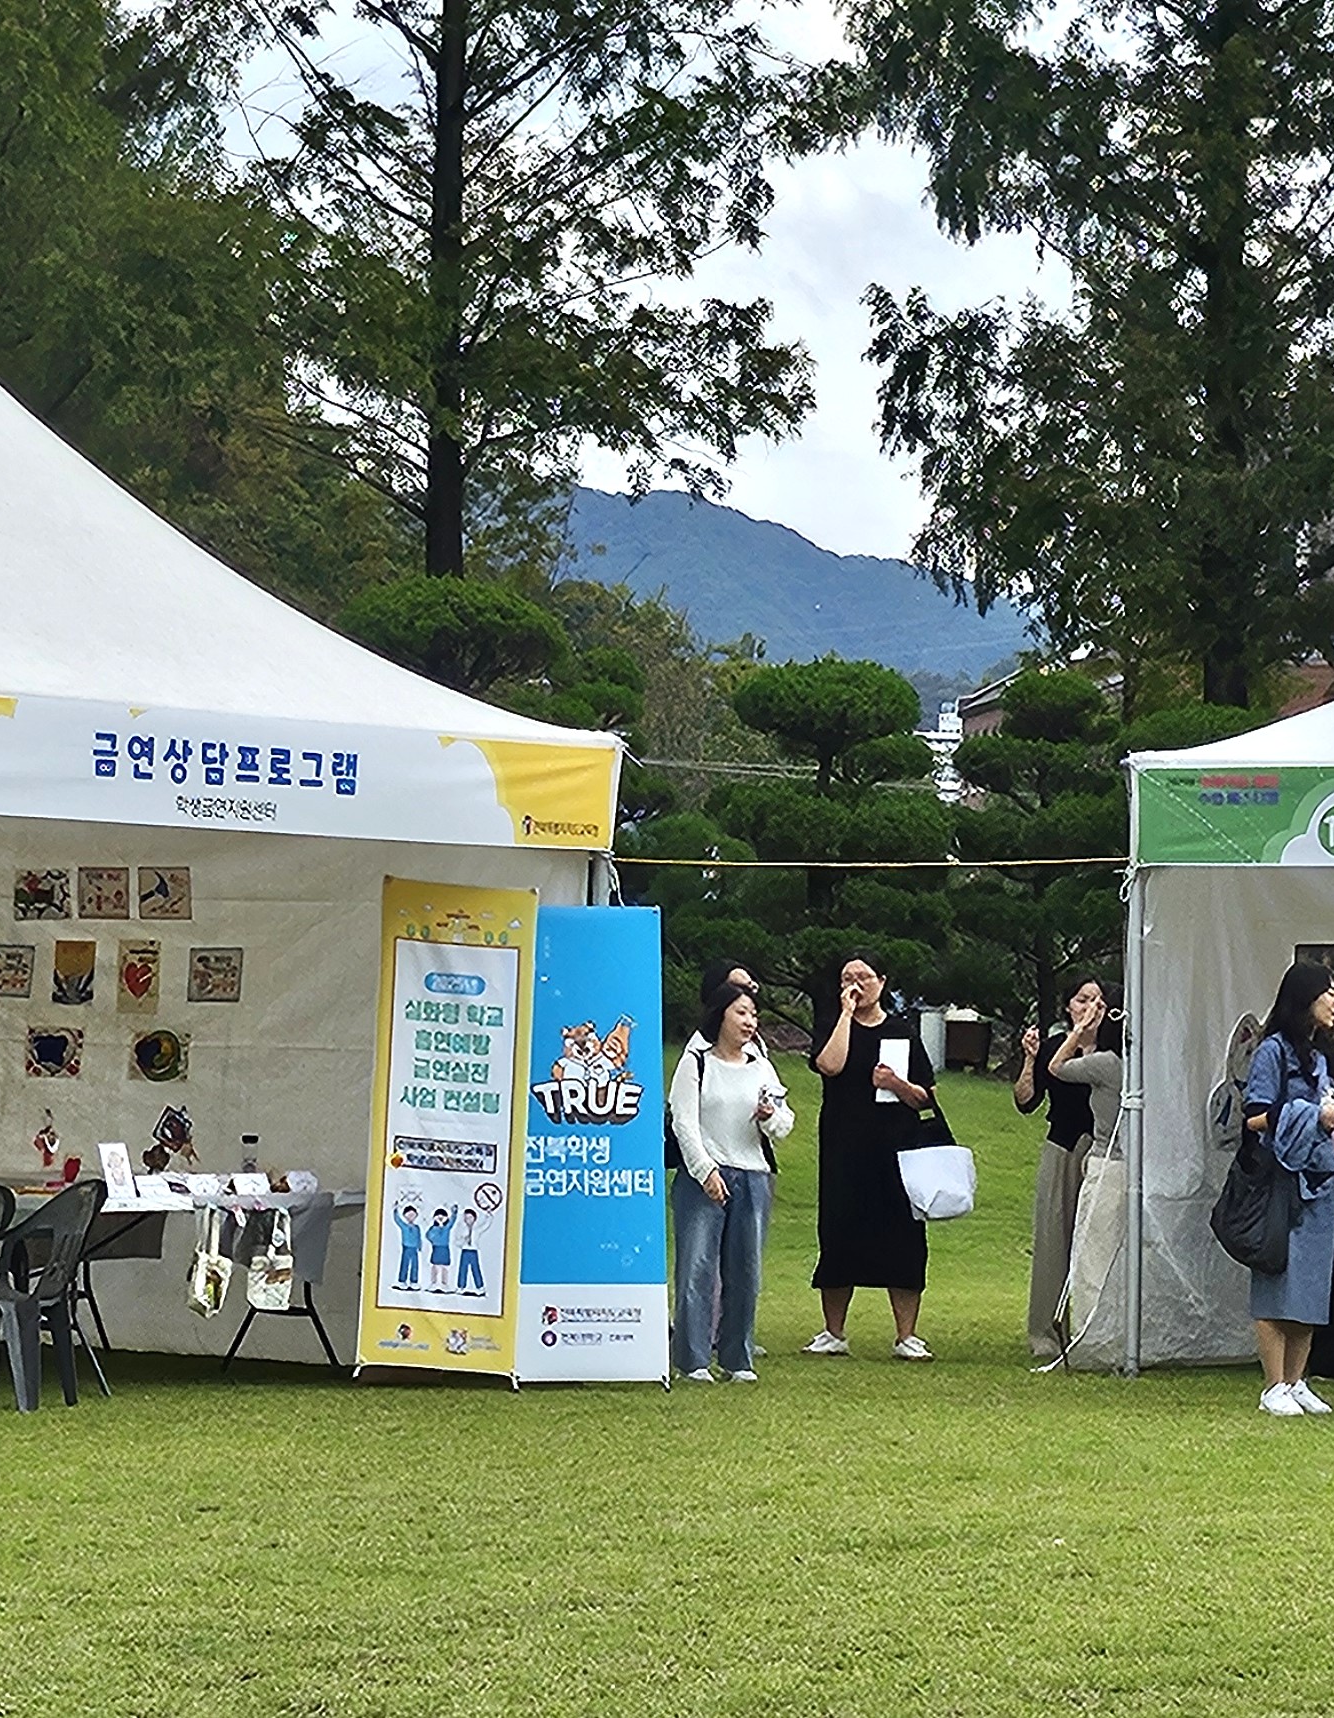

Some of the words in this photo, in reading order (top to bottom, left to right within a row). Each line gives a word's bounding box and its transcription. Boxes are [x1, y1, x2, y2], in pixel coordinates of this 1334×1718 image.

[92, 731, 361, 797] 금연상담프로그램
[175, 794, 278, 822] 학생금연지원센터
[466, 1003, 504, 1027] 학교
[414, 1029, 492, 1056] 흡연예방
[399, 1085, 437, 1109] 사업
[531, 1079, 644, 1118] TRUE
[525, 1134, 610, 1164] 전북학생
[525, 1168, 655, 1197] 금연지원센터
